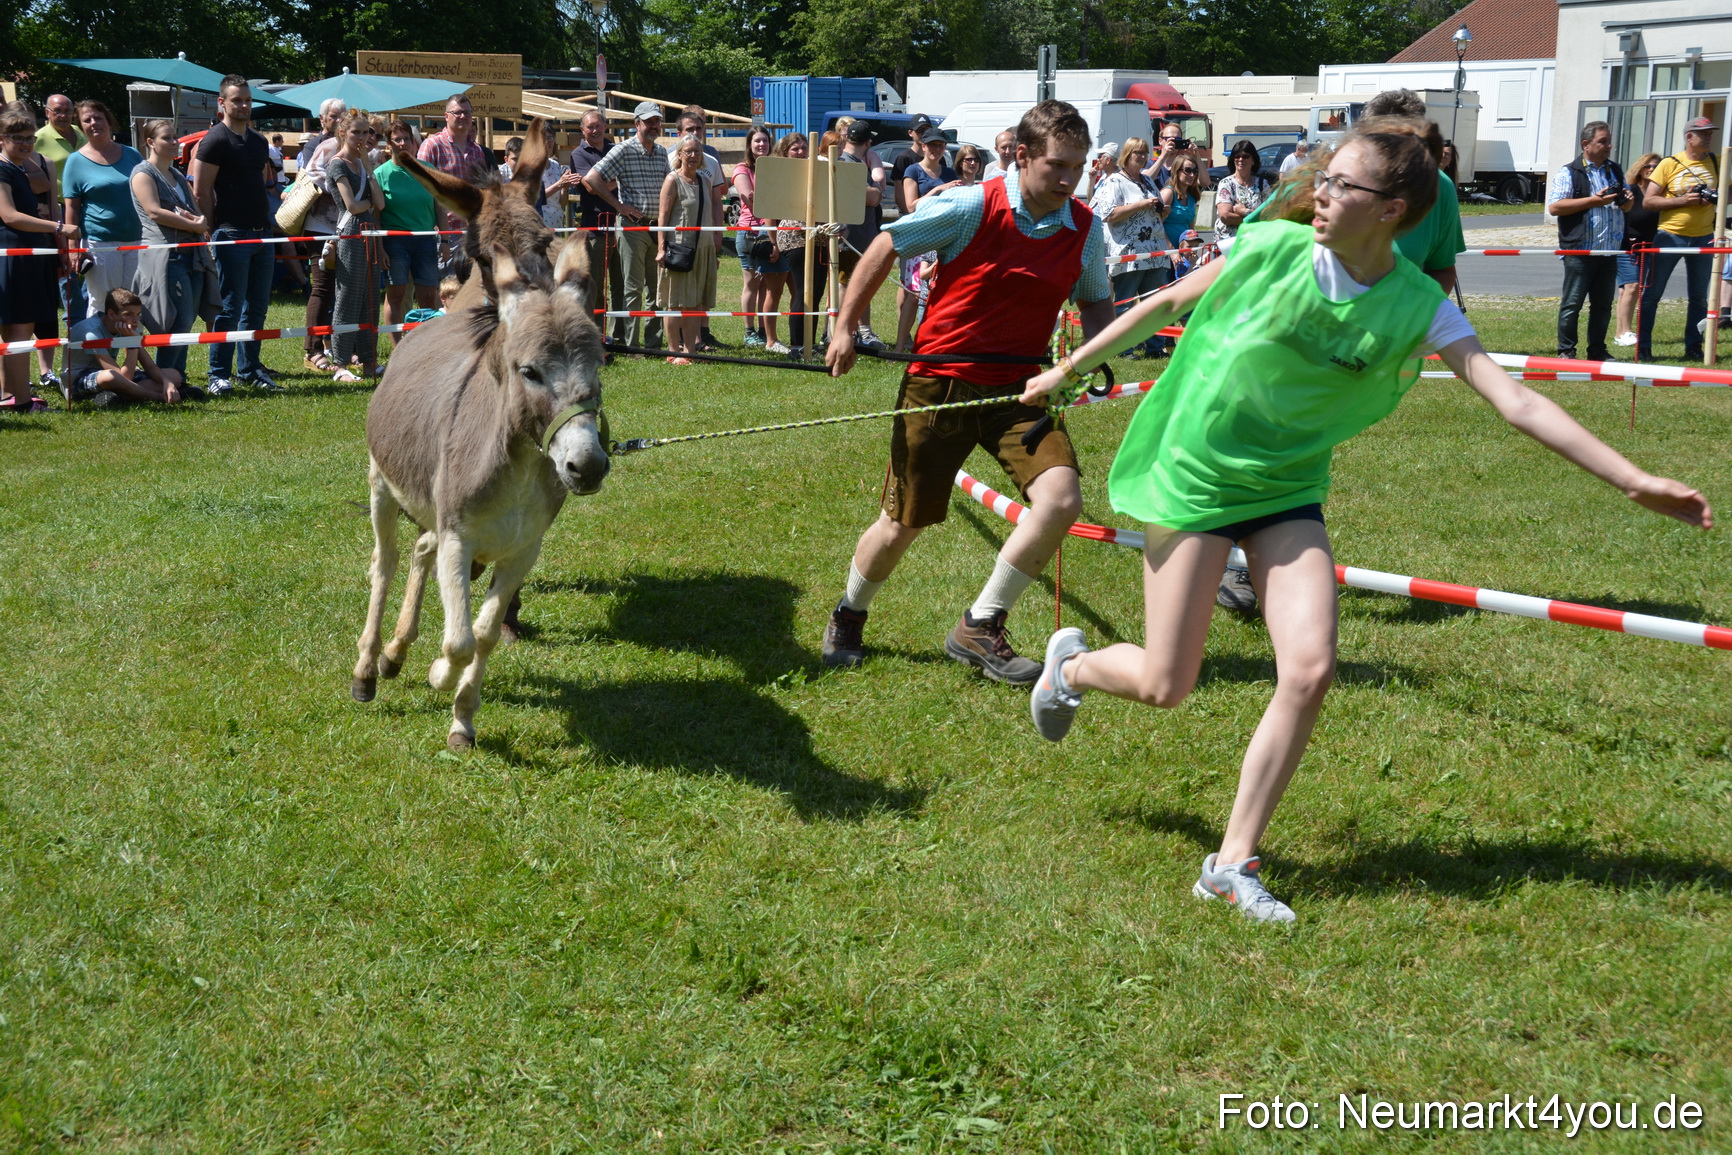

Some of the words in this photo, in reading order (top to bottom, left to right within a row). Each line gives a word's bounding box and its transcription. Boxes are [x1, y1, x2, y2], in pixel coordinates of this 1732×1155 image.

[365, 56, 461, 77] Stauferbergesel
[468, 57, 487, 67] Fam.
[753, 79, 762, 96] P
[753, 102, 763, 113] P2
[1328, 355, 1357, 372] JAKO
